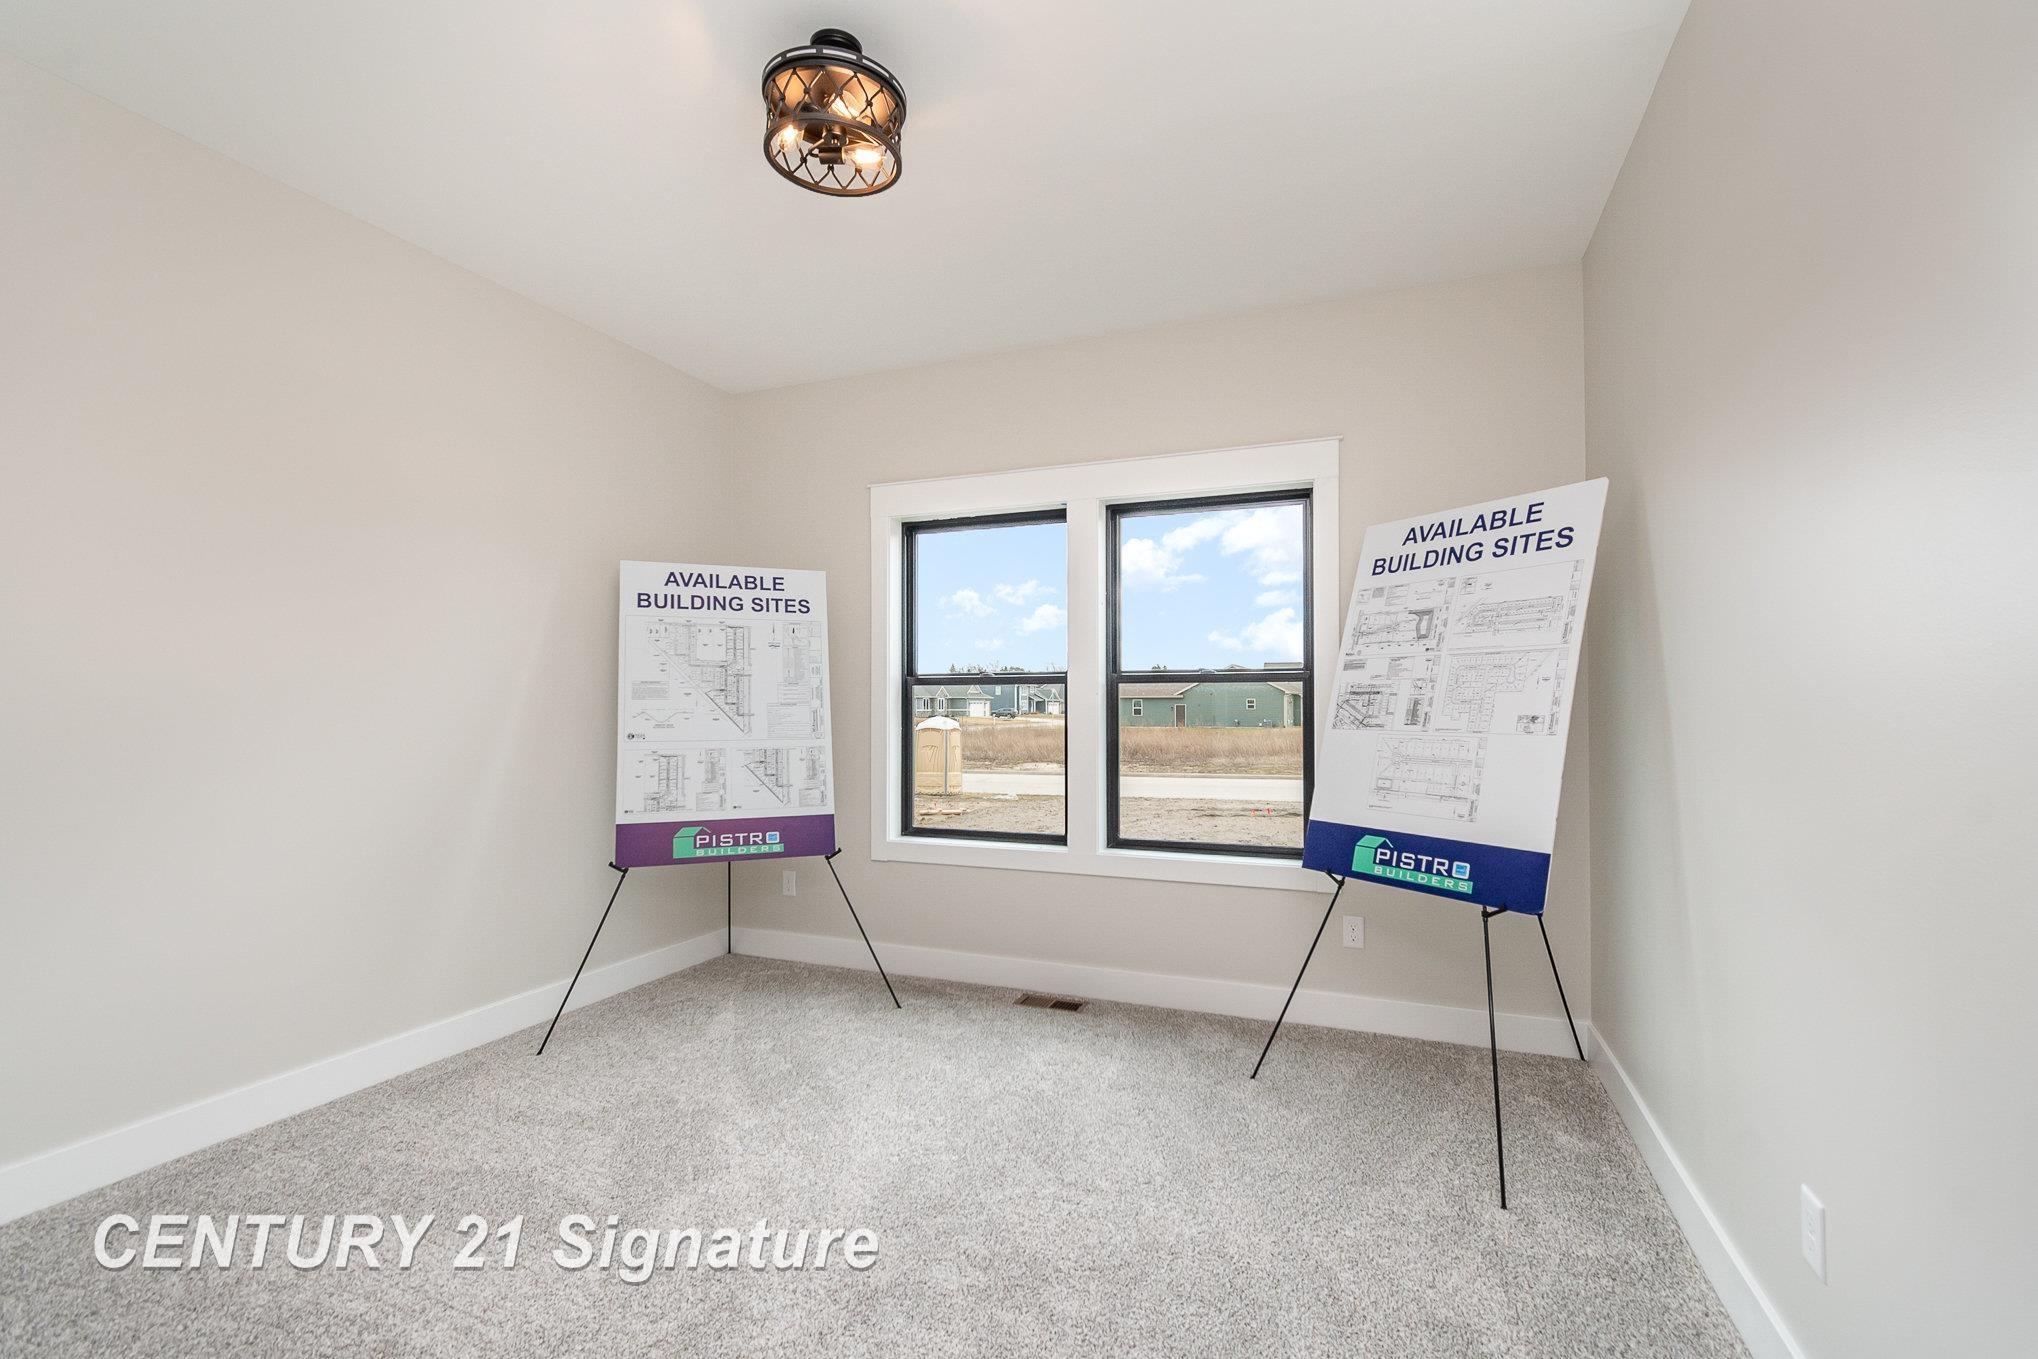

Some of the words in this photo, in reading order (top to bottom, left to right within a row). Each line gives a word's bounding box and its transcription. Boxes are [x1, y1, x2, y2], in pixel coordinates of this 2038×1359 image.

[1402, 502, 1544, 546] AVAILABLE
[1371, 542, 1484, 576] BUILDING
[1491, 526, 1575, 558] SITES
[664, 572, 785, 591] AVAILABLE
[637, 592, 744, 611] BUILDING
[751, 597, 811, 614] SITES
[695, 845, 781, 856] BUILDERS
[696, 831, 780, 848] PISTRO
[1375, 848, 1471, 879] PISTRO
[1374, 866, 1469, 891] BUILDERS
